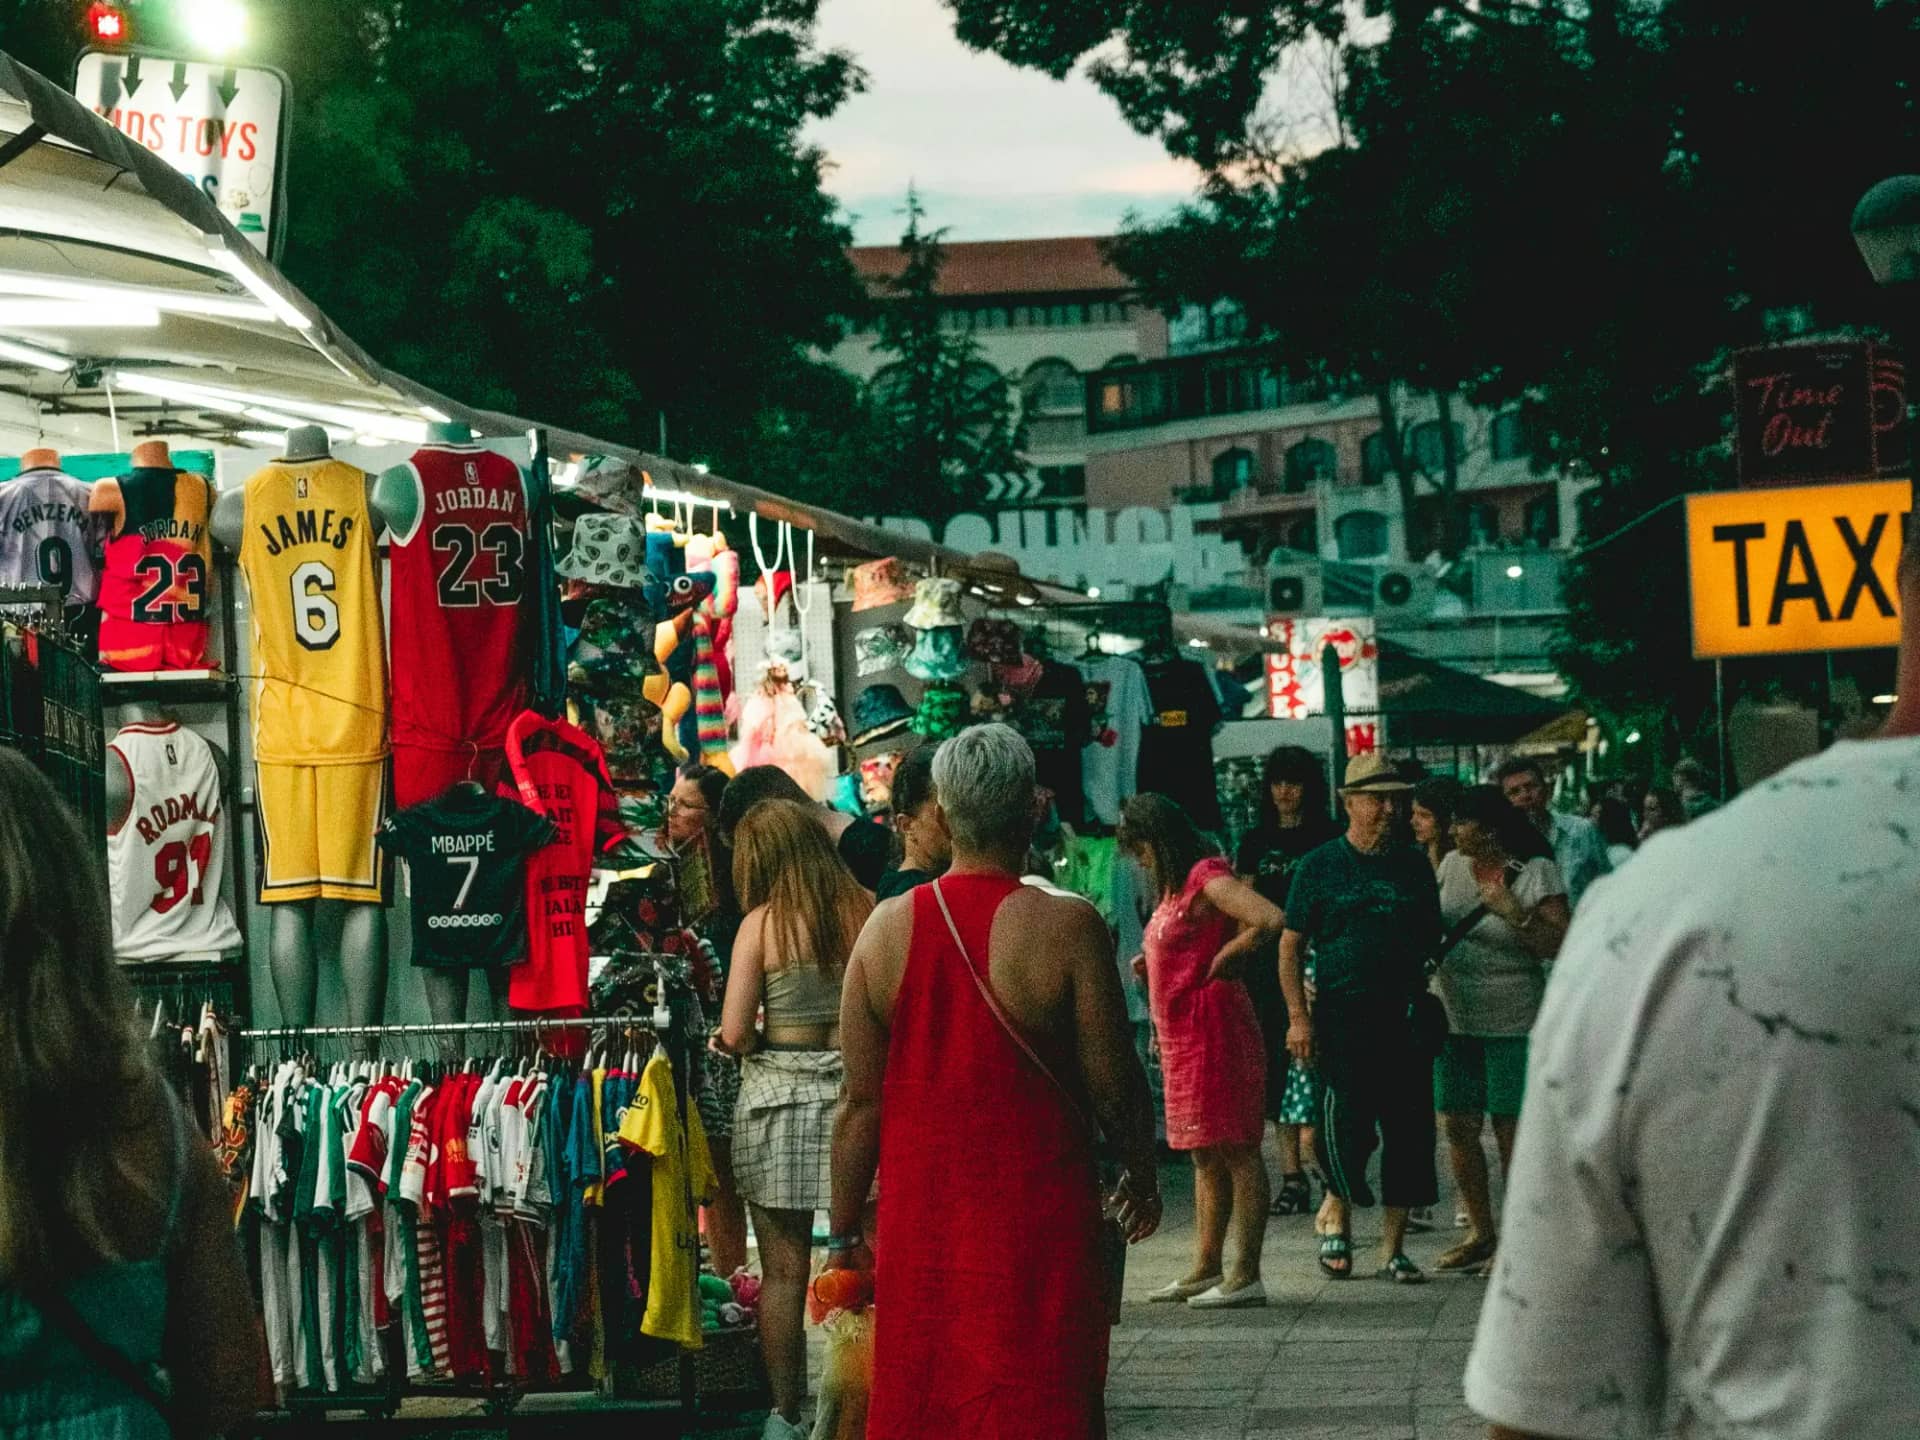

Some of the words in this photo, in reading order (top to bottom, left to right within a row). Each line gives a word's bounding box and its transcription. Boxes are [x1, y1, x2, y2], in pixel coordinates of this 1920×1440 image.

[94, 105, 165, 151] IDS
[175, 116, 258, 161] TOYS
[1748, 371, 1844, 415] Time
[1762, 412, 1832, 457] Out
[435, 486, 516, 514] JORDAN
[138, 518, 202, 546] JORDAN
[260, 509, 353, 556] JAMES
[131, 552, 207, 625] 23
[432, 522, 524, 608] 23
[1713, 512, 1912, 628] TAX
[290, 560, 341, 652] 6
[431, 830, 496, 854] MBAPPÉ
[150, 831, 212, 914] 91
[446, 855, 480, 910] 7
[427, 913, 503, 929] ooredoo
